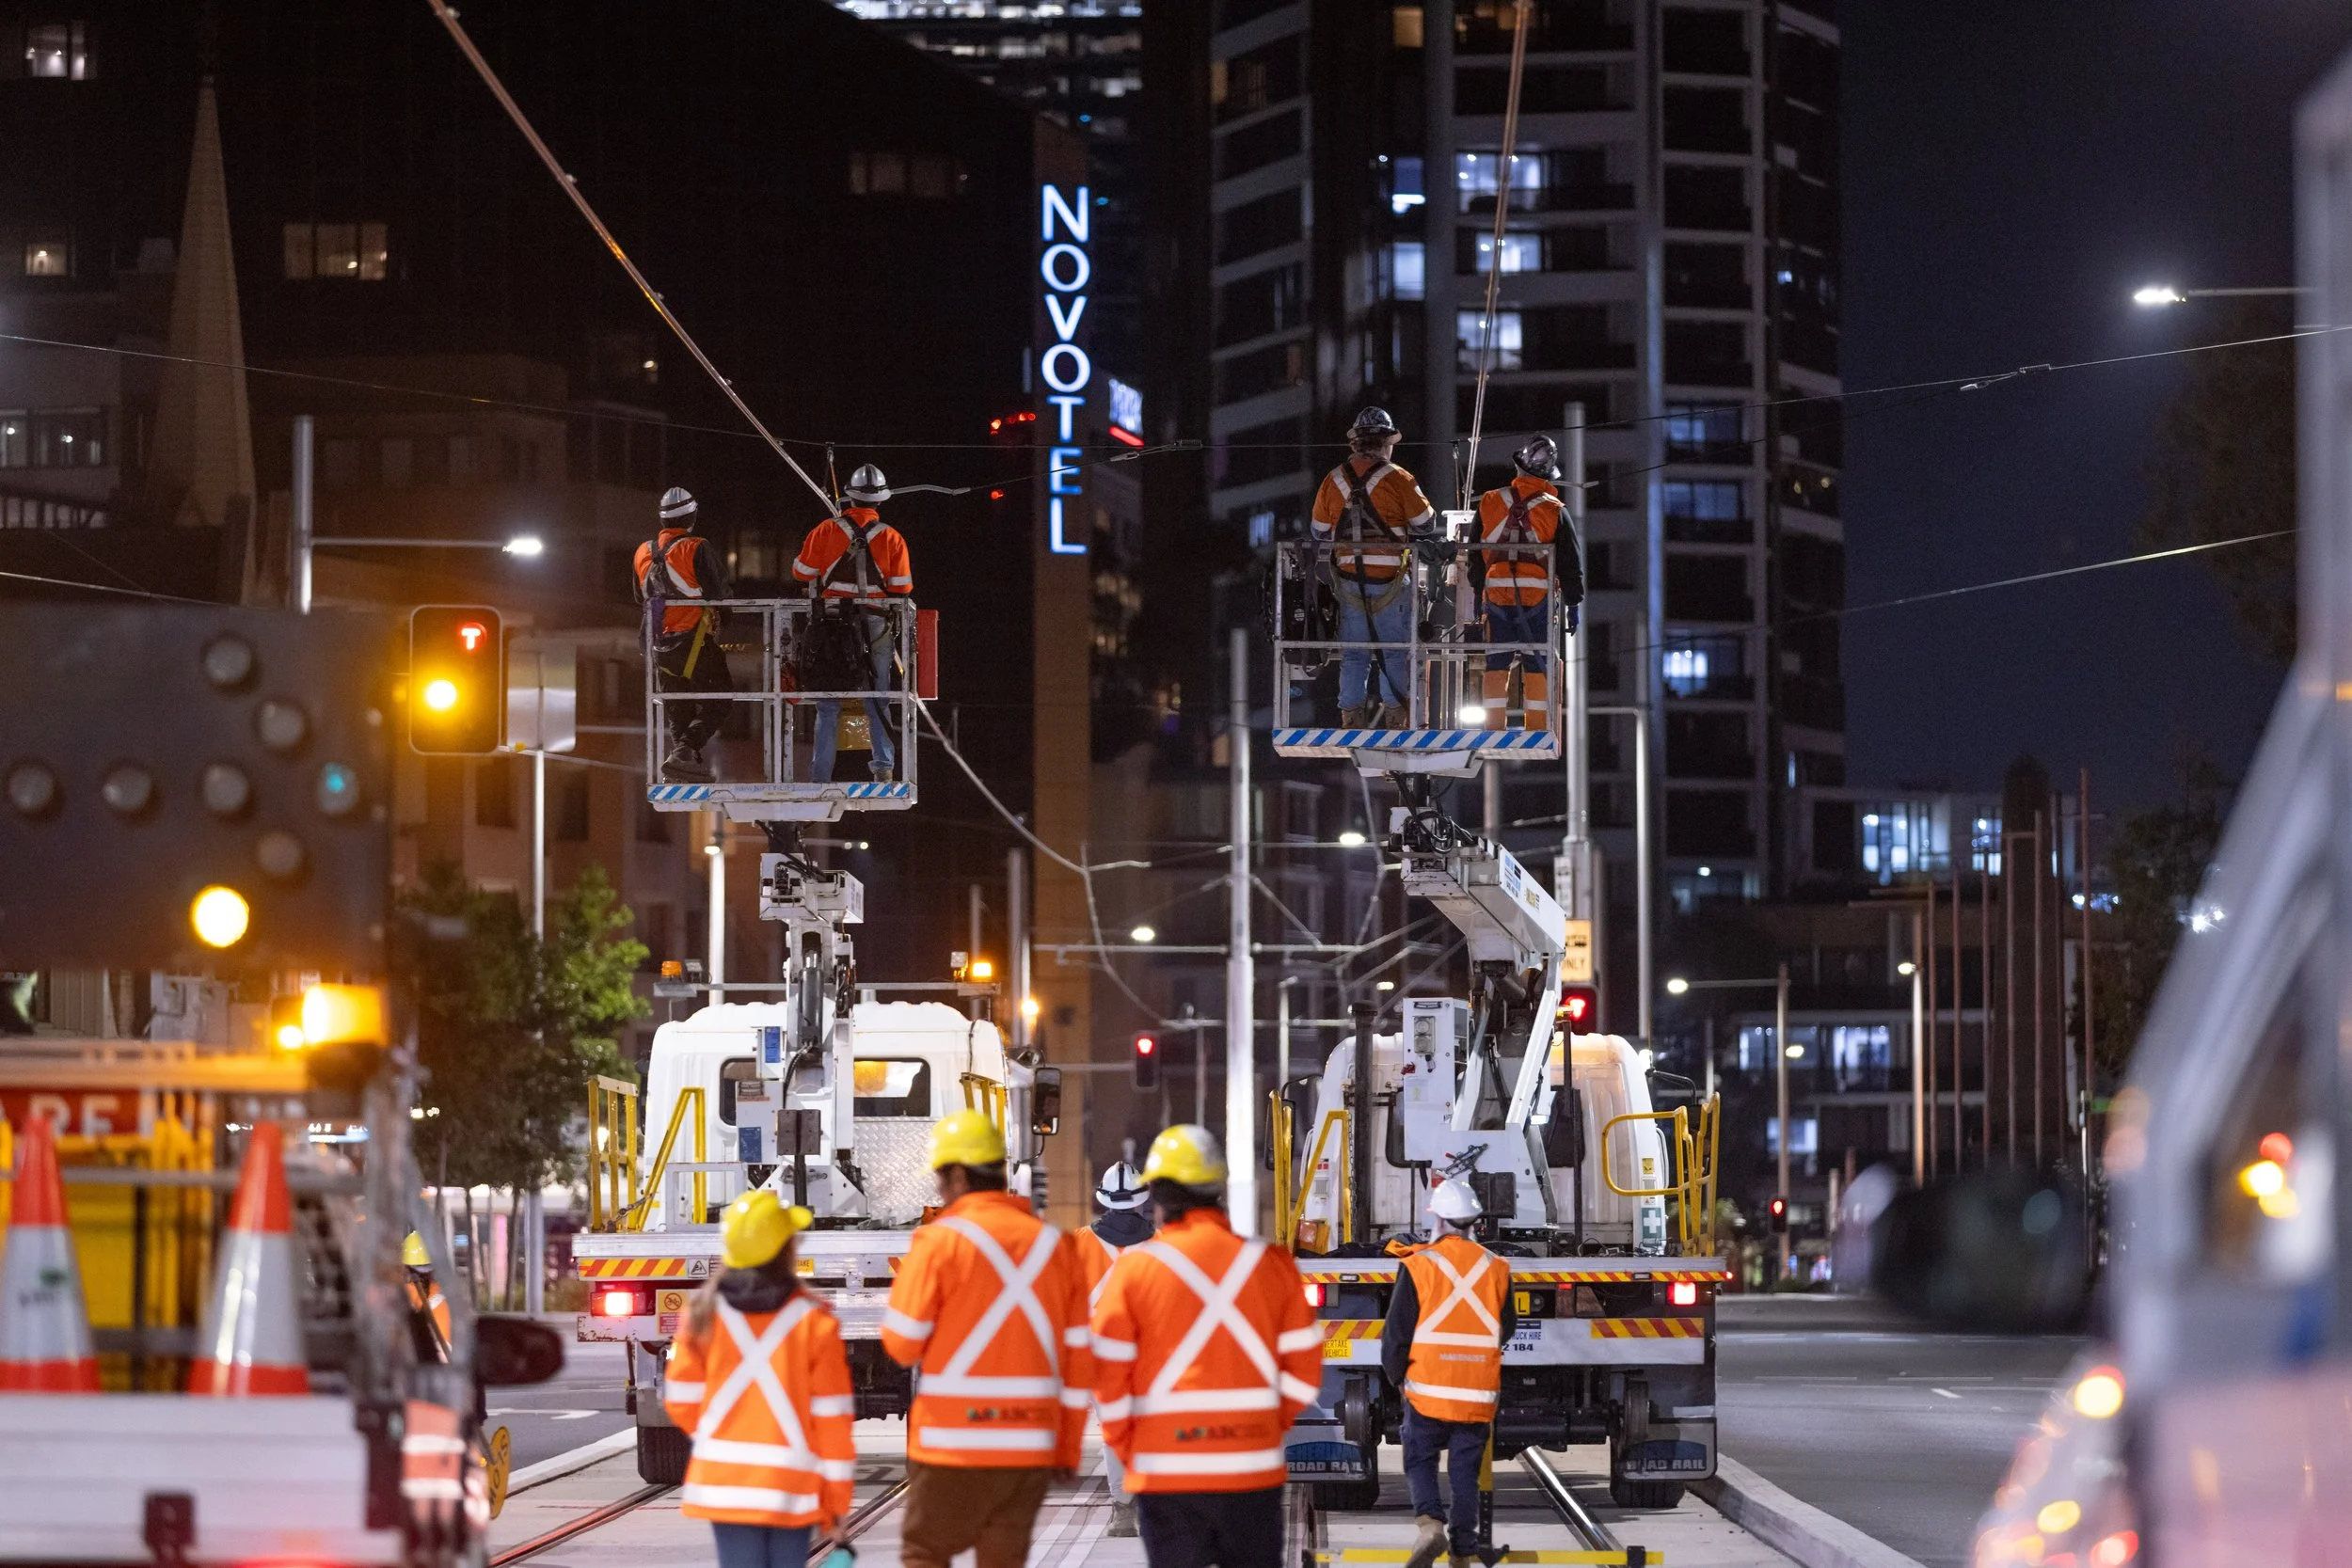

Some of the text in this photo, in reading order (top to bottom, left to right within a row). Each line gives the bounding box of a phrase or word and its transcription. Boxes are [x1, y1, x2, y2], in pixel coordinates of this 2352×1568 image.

[1040, 183, 1091, 555] NOVOTEL
[461, 627, 482, 650] T
[1529, 1331, 1542, 1340] HIRE
[1513, 1343, 1534, 1352] 184
[1325, 1349, 1348, 1358] VEHICLE
[1286, 1461, 1363, 1472] ROAD RAIL
[1672, 1459, 1706, 1470] RAIL
